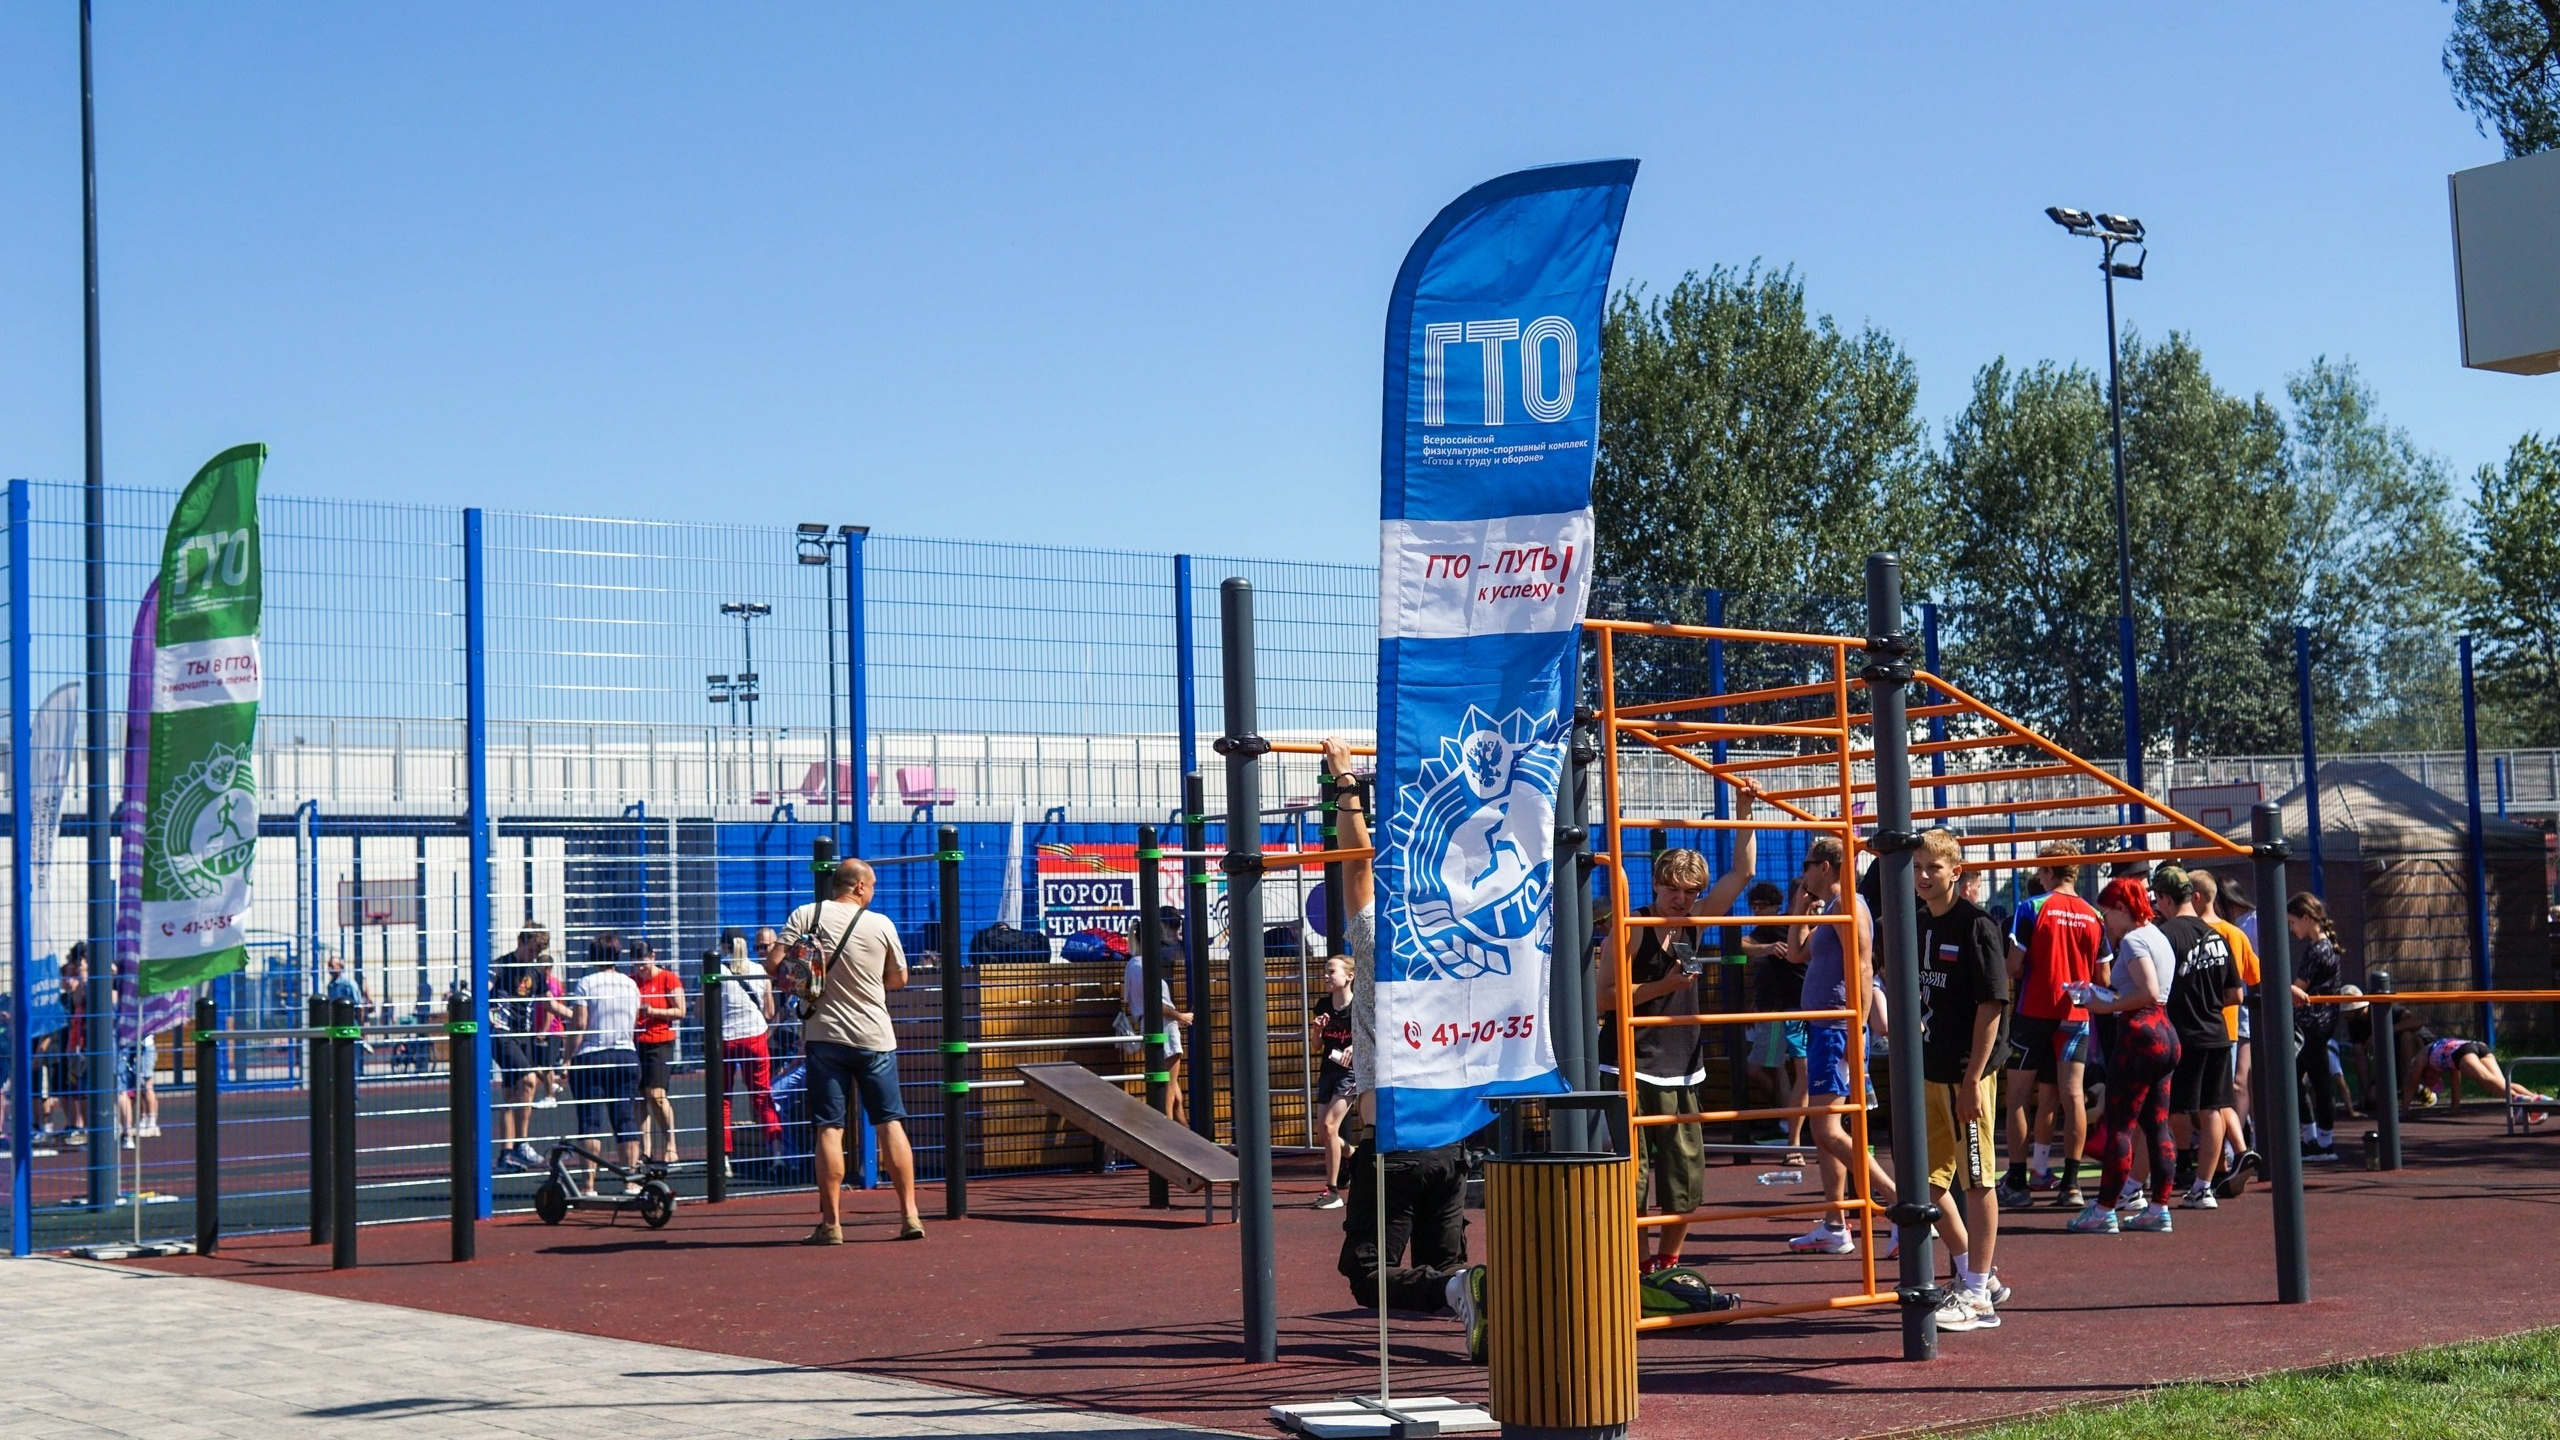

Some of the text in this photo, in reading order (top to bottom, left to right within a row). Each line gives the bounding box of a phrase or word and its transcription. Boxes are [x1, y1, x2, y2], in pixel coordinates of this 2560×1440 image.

[1424, 316, 1578, 427] ГТО
[1423, 435, 1495, 446] Всероссийский
[1423, 439, 1589, 457] физкультурно-спортивный комплекс
[1422, 454, 1544, 468] «Готов к труду и обороне»
[174, 527, 250, 595] ГТО
[1425, 554, 1472, 579] ГТО
[1494, 546, 1558, 575] ПУТЬ
[1478, 582, 1554, 604] к успеху
[186, 660, 210, 676] ТЫ
[213, 658, 222, 673] В
[214, 844, 249, 875] ГТО
[1046, 883, 1124, 907] ГОРОД
[1494, 878, 1541, 937] ГТО
[1431, 1014, 1534, 1047] 41-10-35
